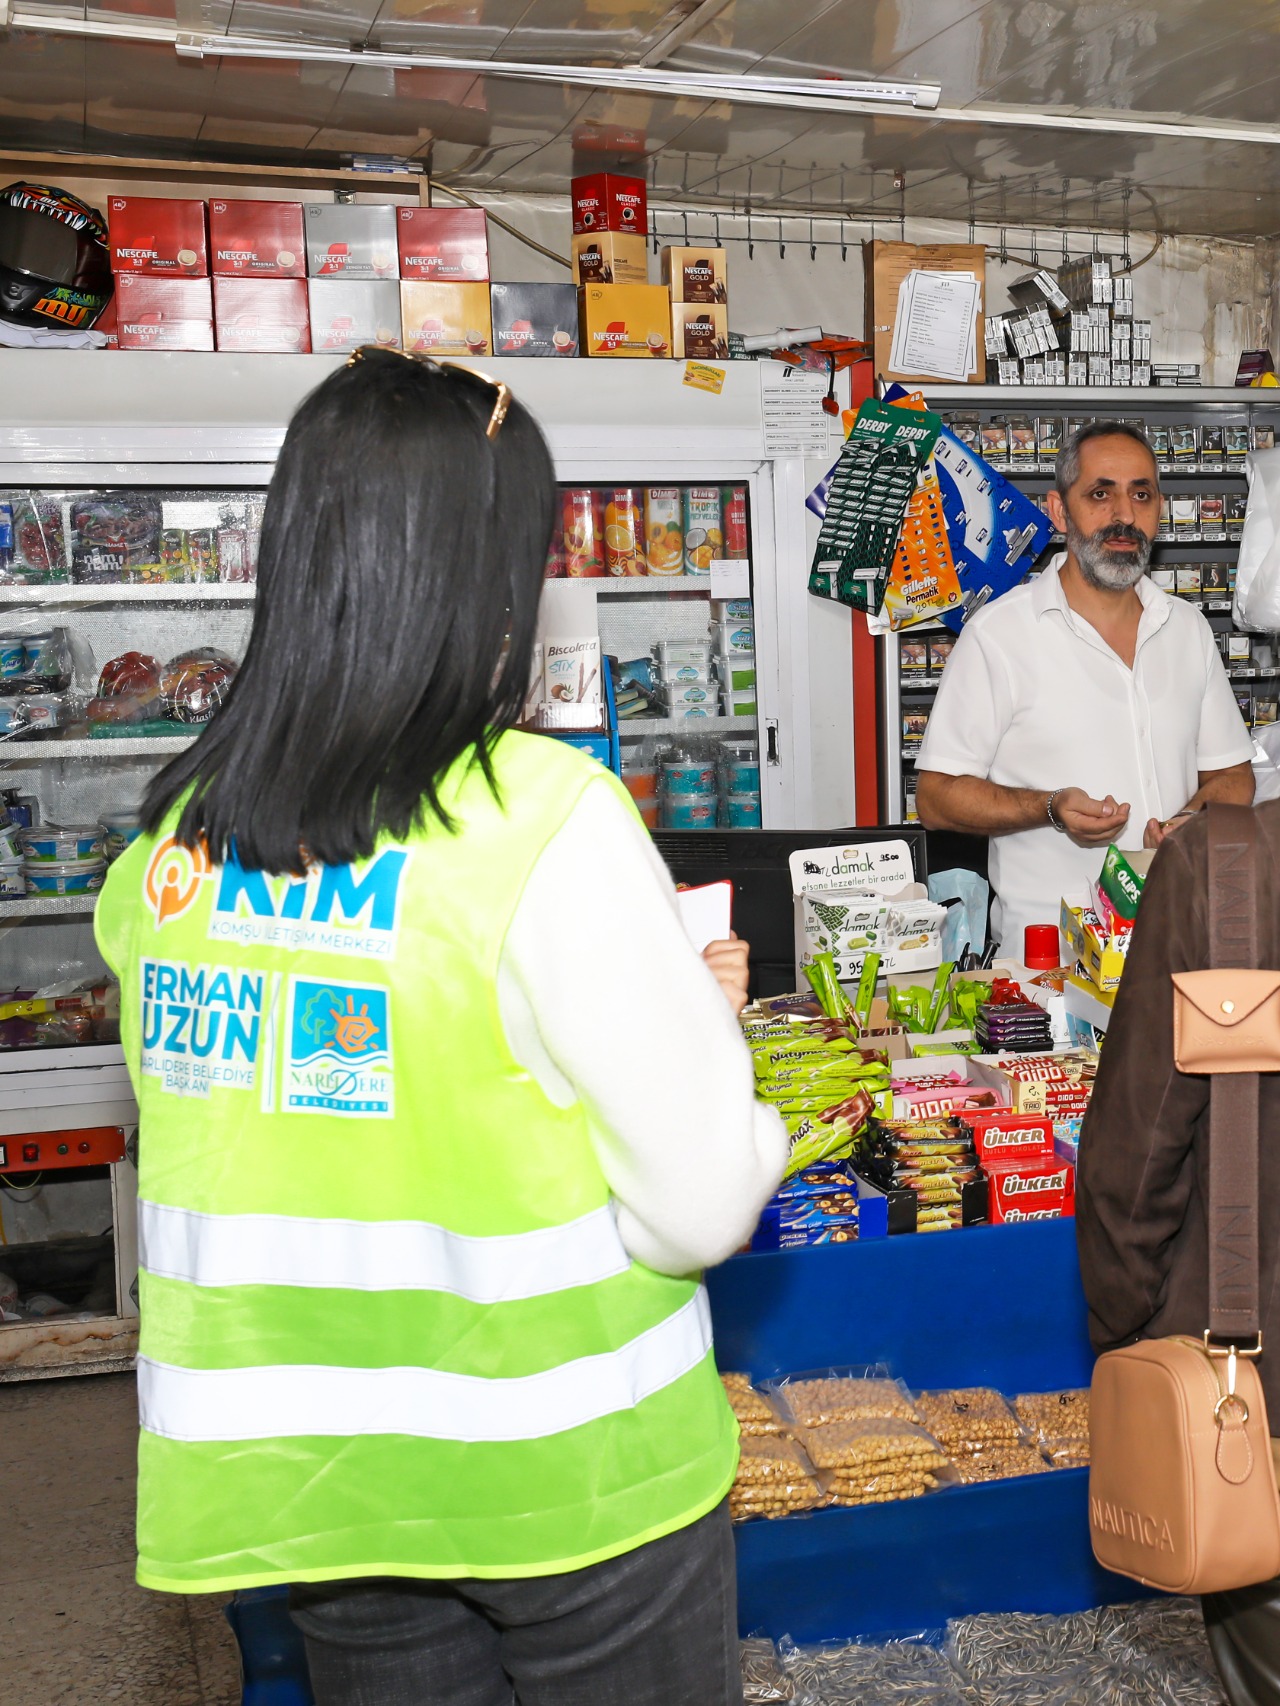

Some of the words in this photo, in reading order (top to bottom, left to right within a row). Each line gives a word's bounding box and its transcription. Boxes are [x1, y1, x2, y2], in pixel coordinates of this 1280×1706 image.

[856, 417, 893, 434] DERBY
[895, 425, 931, 441] DERBY
[900, 575, 938, 598] Gillette
[906, 586, 940, 606] Permatik
[547, 641, 597, 656] Biscolata
[832, 852, 875, 876] damak
[830, 878, 865, 888] lezzetler
[868, 875, 879, 884] bir
[144, 963, 263, 1012] ERMAN
[142, 1000, 260, 1064] UZUN
[141, 1056, 190, 1076] ARLIDERE
[766, 1082, 793, 1092] Nutymax
[984, 1127, 1046, 1148] ÜLKER
[1002, 1174, 1066, 1196] ÜLKER
[1091, 1496, 1175, 1553] NAUTICA
